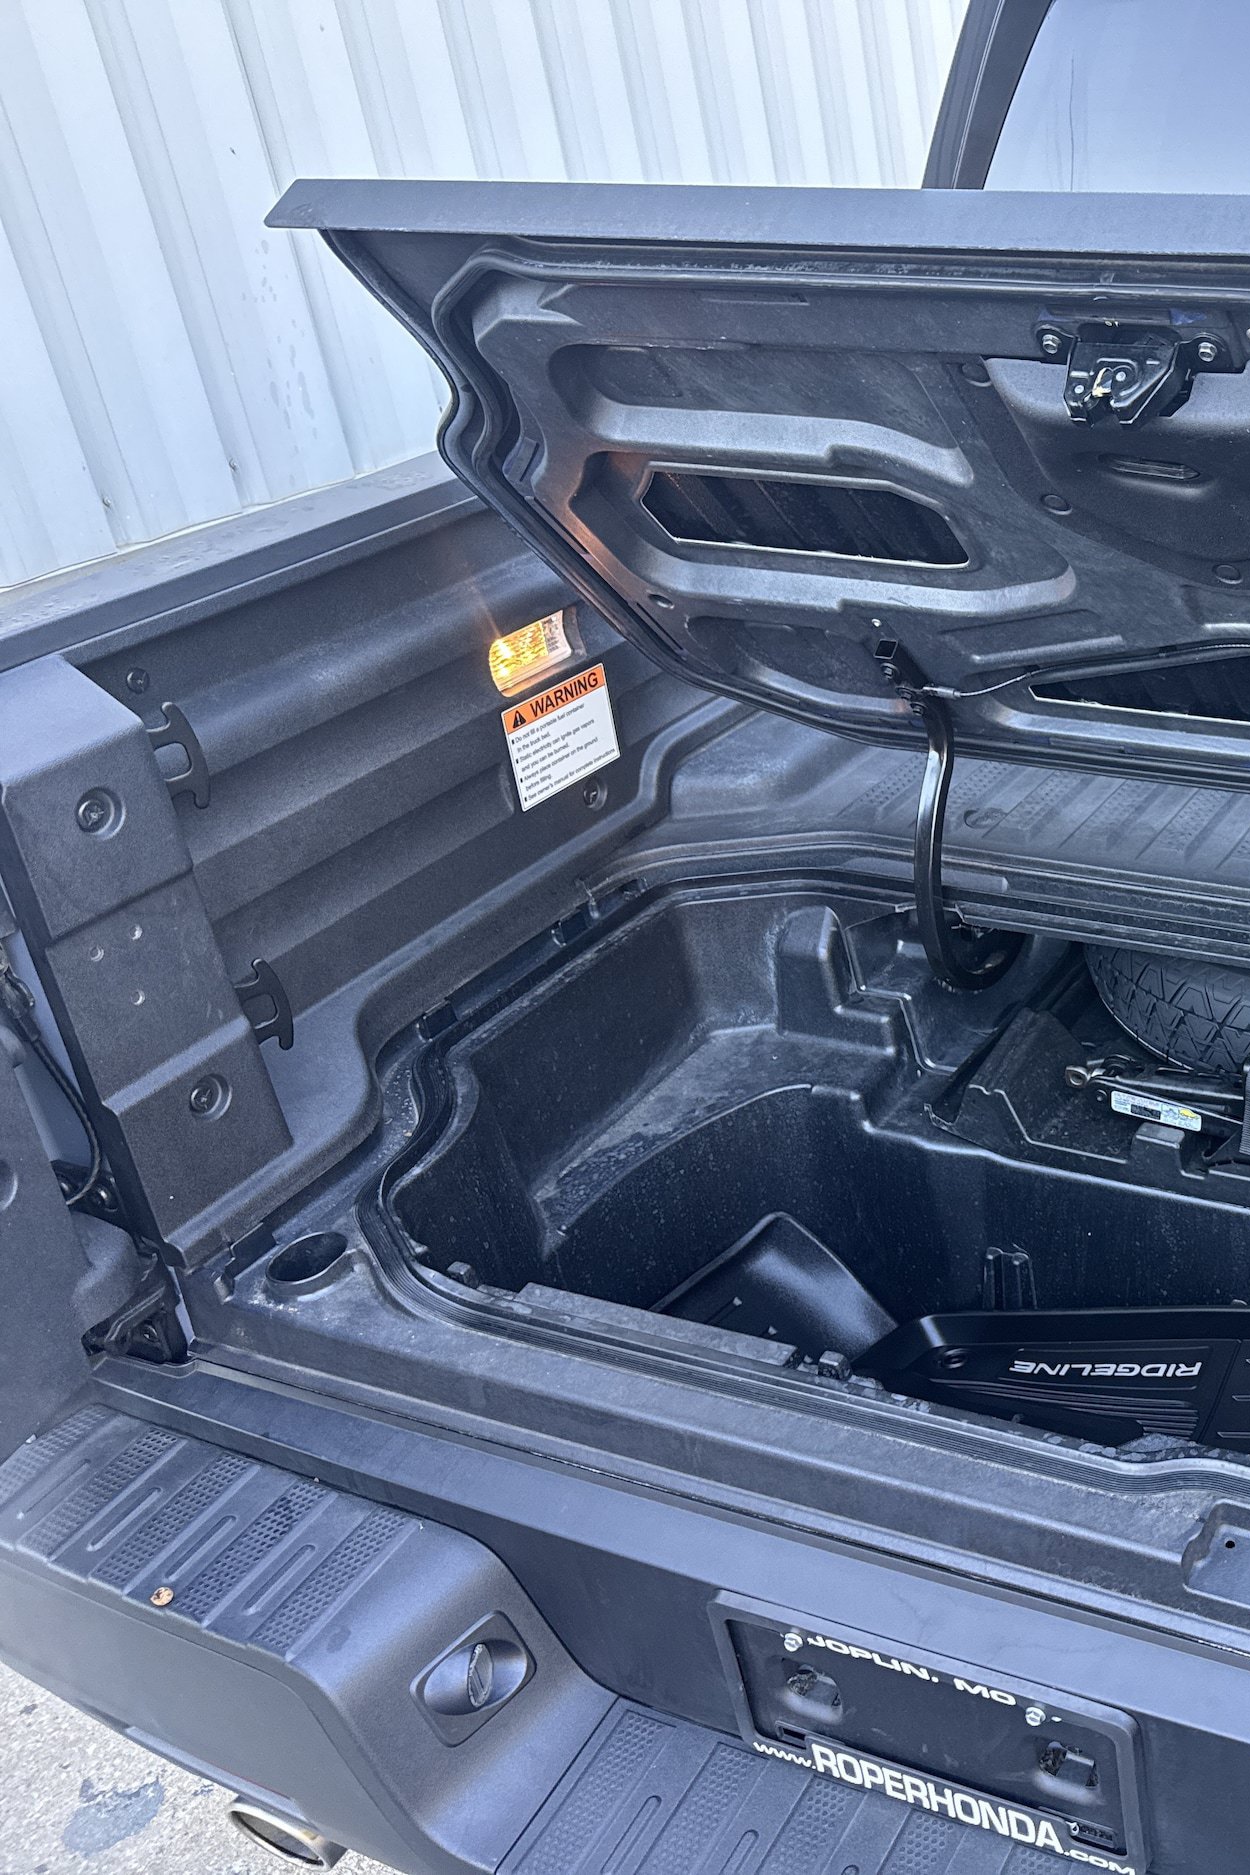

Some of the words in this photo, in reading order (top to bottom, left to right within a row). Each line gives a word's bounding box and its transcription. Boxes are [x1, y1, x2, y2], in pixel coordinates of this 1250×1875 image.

[530, 672, 598, 717] WARNING
[539, 716, 557, 731] portable
[557, 712, 565, 720] fuel
[565, 702, 584, 716] container
[519, 751, 532, 762] Static
[532, 740, 551, 756] electricity
[560, 730, 572, 741] ignite
[572, 726, 580, 735] gas
[580, 718, 594, 730] vapors
[529, 735, 540, 746] truck
[521, 762, 530, 772] and
[530, 759, 539, 768] you
[539, 754, 547, 762] can
[524, 769, 539, 782] Always
[539, 762, 551, 774] place
[551, 751, 569, 766] container
[583, 736, 598, 749] ground
[525, 779, 539, 791] before
[528, 791, 536, 800] See
[537, 782, 553, 795] owner's
[553, 773, 568, 785] manual
[575, 759, 593, 774] complete
[1009, 1360, 1202, 1378] RIDGELINE
[953, 1678, 1017, 1706] MO
